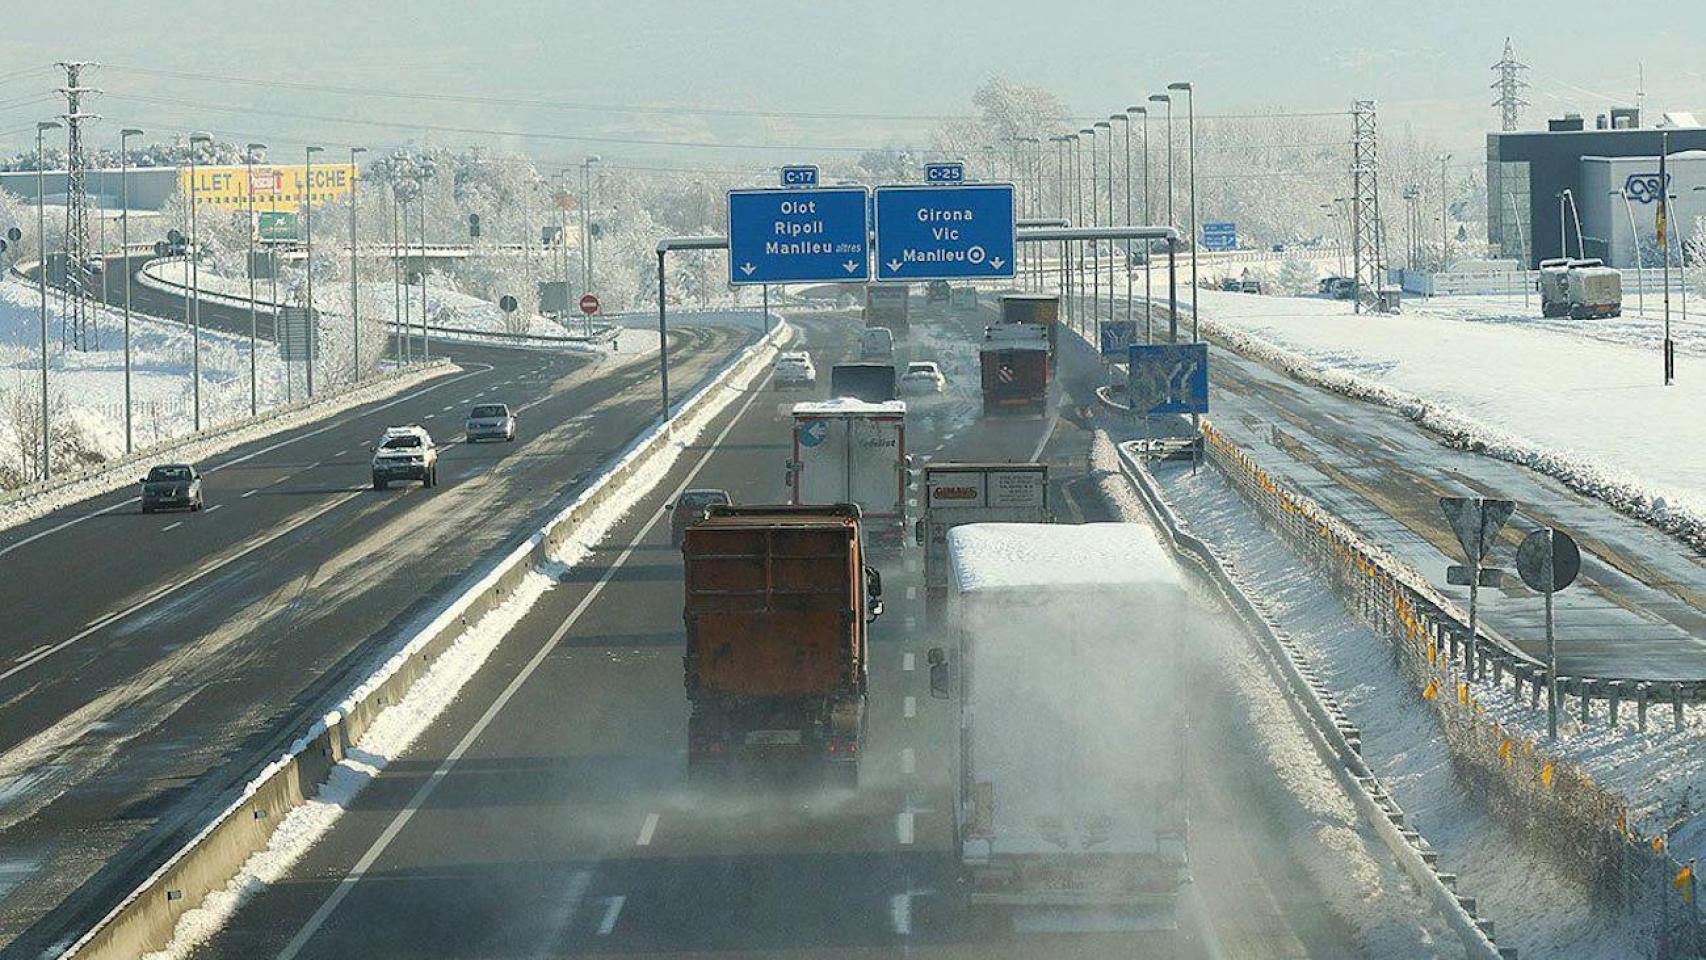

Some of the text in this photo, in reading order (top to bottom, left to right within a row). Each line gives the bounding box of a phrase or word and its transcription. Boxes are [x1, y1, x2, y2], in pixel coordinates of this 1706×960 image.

[295, 170, 345, 189] LECHE
[786, 171, 813, 182] C-17
[929, 168, 960, 179] C-25
[781, 201, 816, 214] Olot
[917, 208, 973, 222] Girona
[774, 221, 823, 237] Ripoll
[932, 227, 959, 240] Vic
[765, 241, 832, 254] Manlleu
[903, 248, 964, 262] Manlleu
